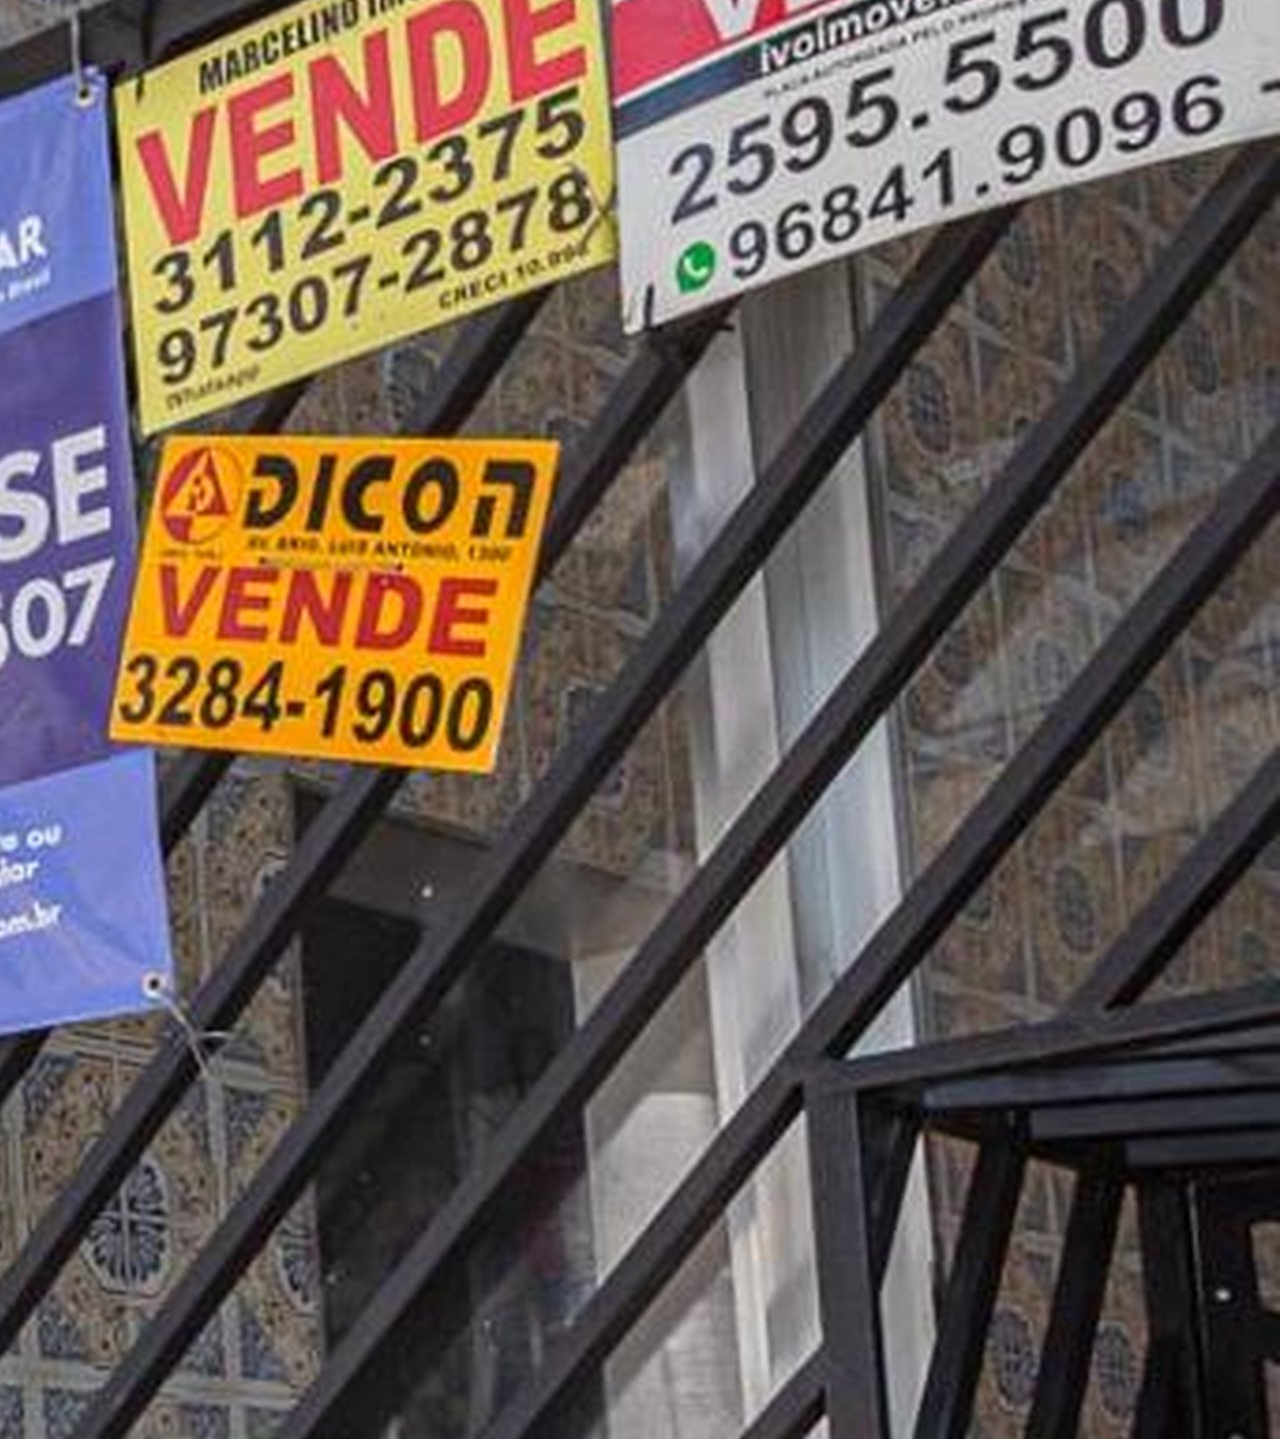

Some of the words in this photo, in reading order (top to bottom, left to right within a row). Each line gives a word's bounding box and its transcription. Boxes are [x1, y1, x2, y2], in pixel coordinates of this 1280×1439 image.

[152, 86, 586, 314] 3112-2375
[729, 75, 1226, 280] 96841.9096
[156, 168, 592, 387] 97307-2878
[157, 564, 500, 660] VENDE
[117, 652, 495, 755] 3284-1900
[26, 824, 62, 849] ou
